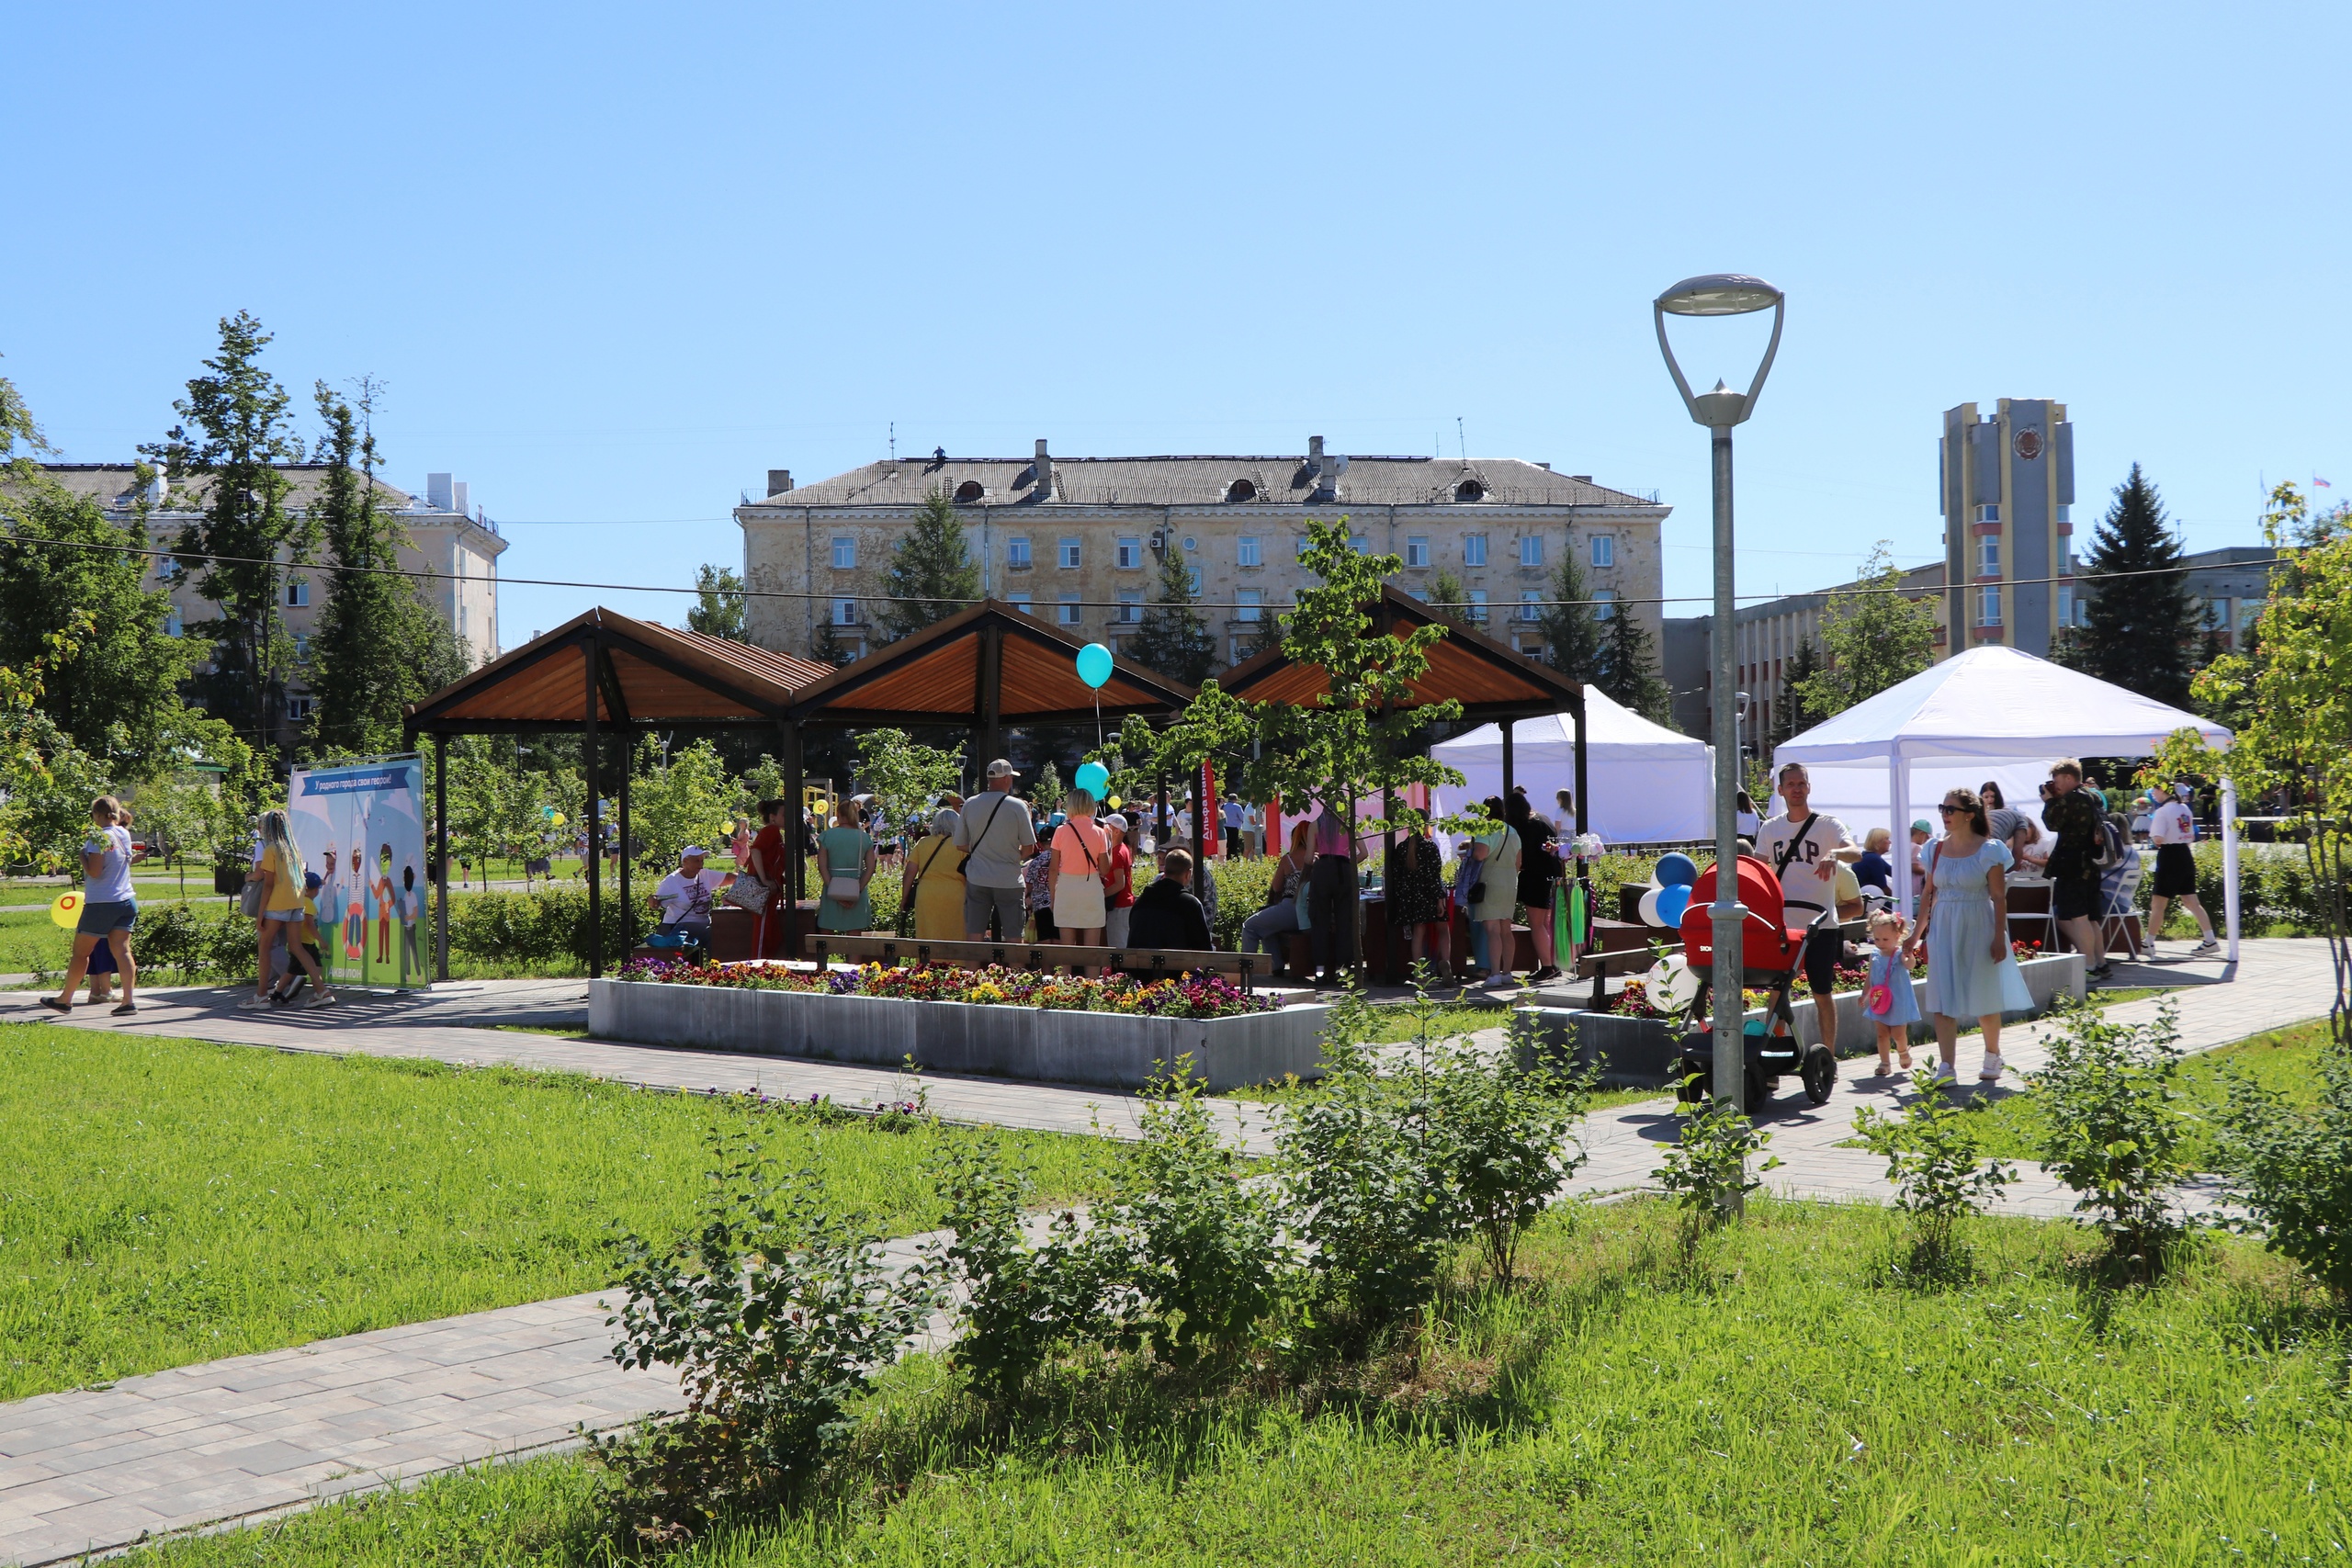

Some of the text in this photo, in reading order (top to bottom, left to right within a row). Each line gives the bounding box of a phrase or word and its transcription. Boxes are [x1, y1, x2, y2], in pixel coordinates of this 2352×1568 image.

[315, 781, 320, 790] У
[319, 781, 339, 792] родного
[340, 779, 356, 790] города
[357, 778, 370, 786] свои
[1203, 800, 1211, 840] Альфа
[1773, 839, 1819, 865] GAP
